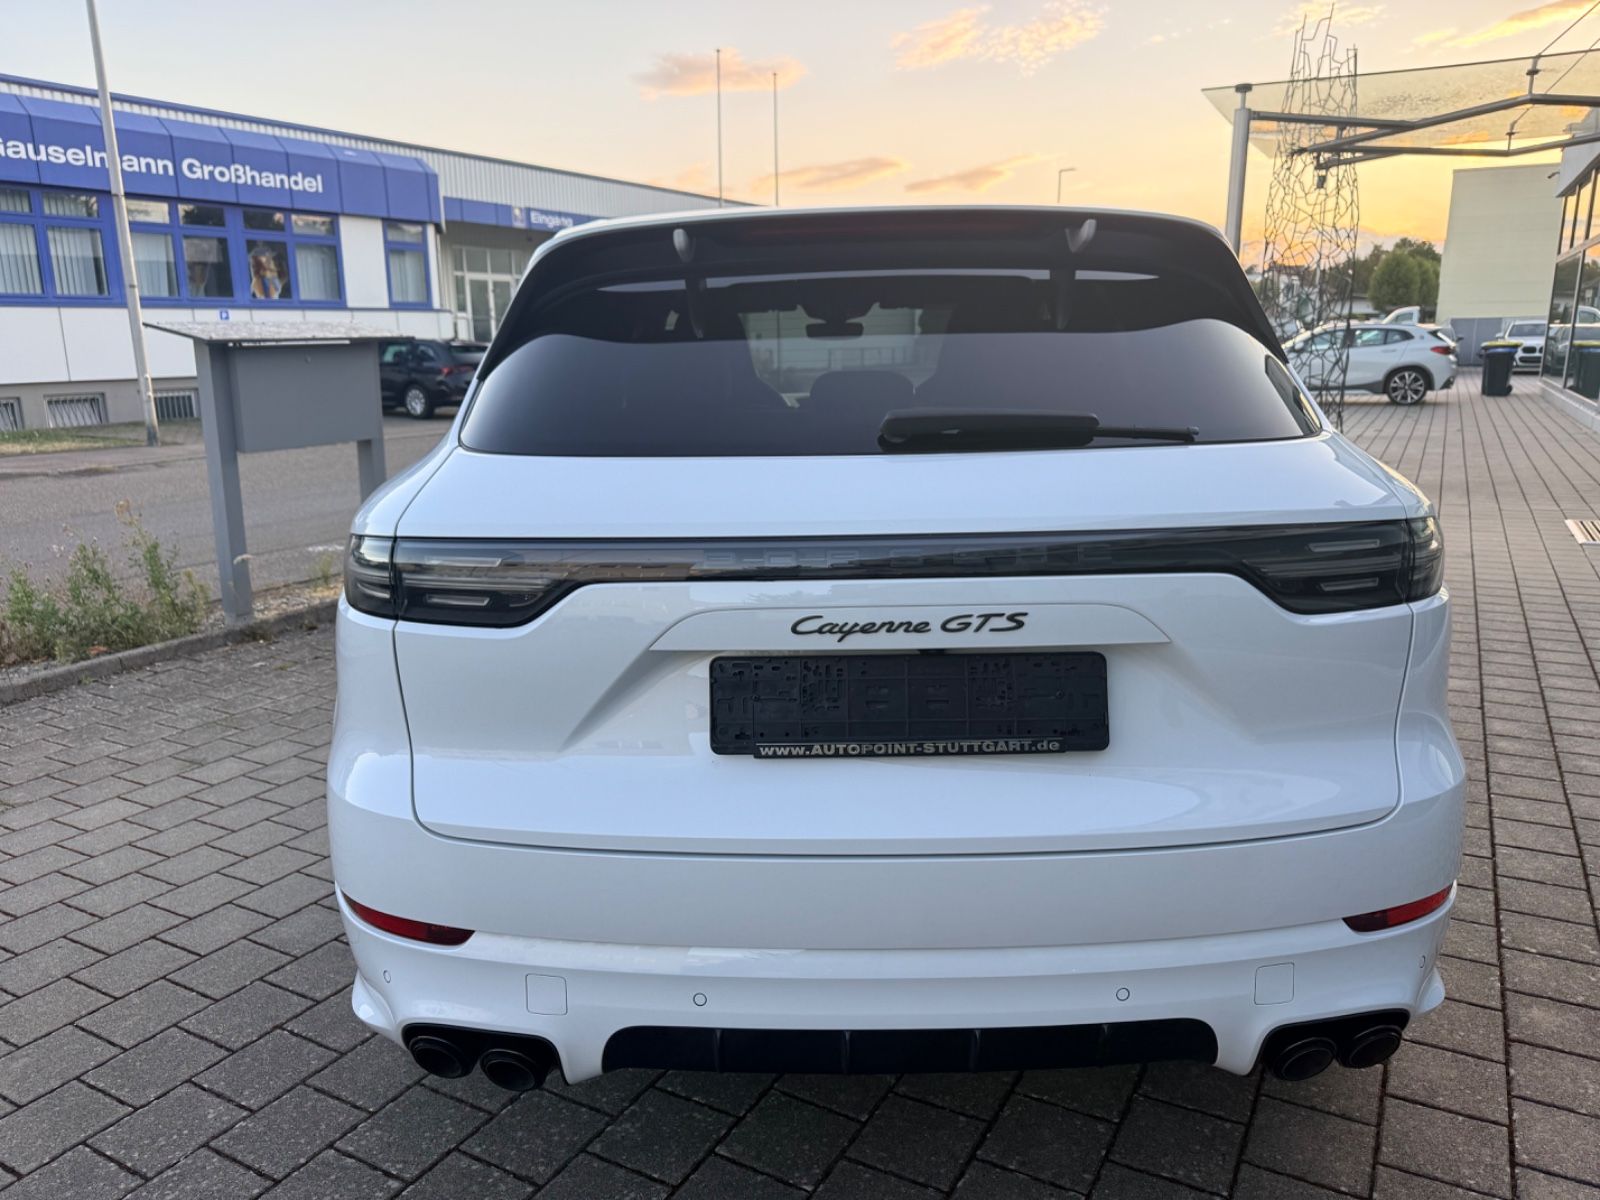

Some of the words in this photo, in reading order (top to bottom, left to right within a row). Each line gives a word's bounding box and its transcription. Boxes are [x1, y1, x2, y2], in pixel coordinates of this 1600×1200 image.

[0, 137, 174, 176] auselmann
[182, 158, 323, 193] Großhandel
[791, 614, 932, 642] Cayenne
[940, 612, 1029, 632] GTS
[759, 739, 1060, 756] www.AUTOPOINT-STUTTGART.de
